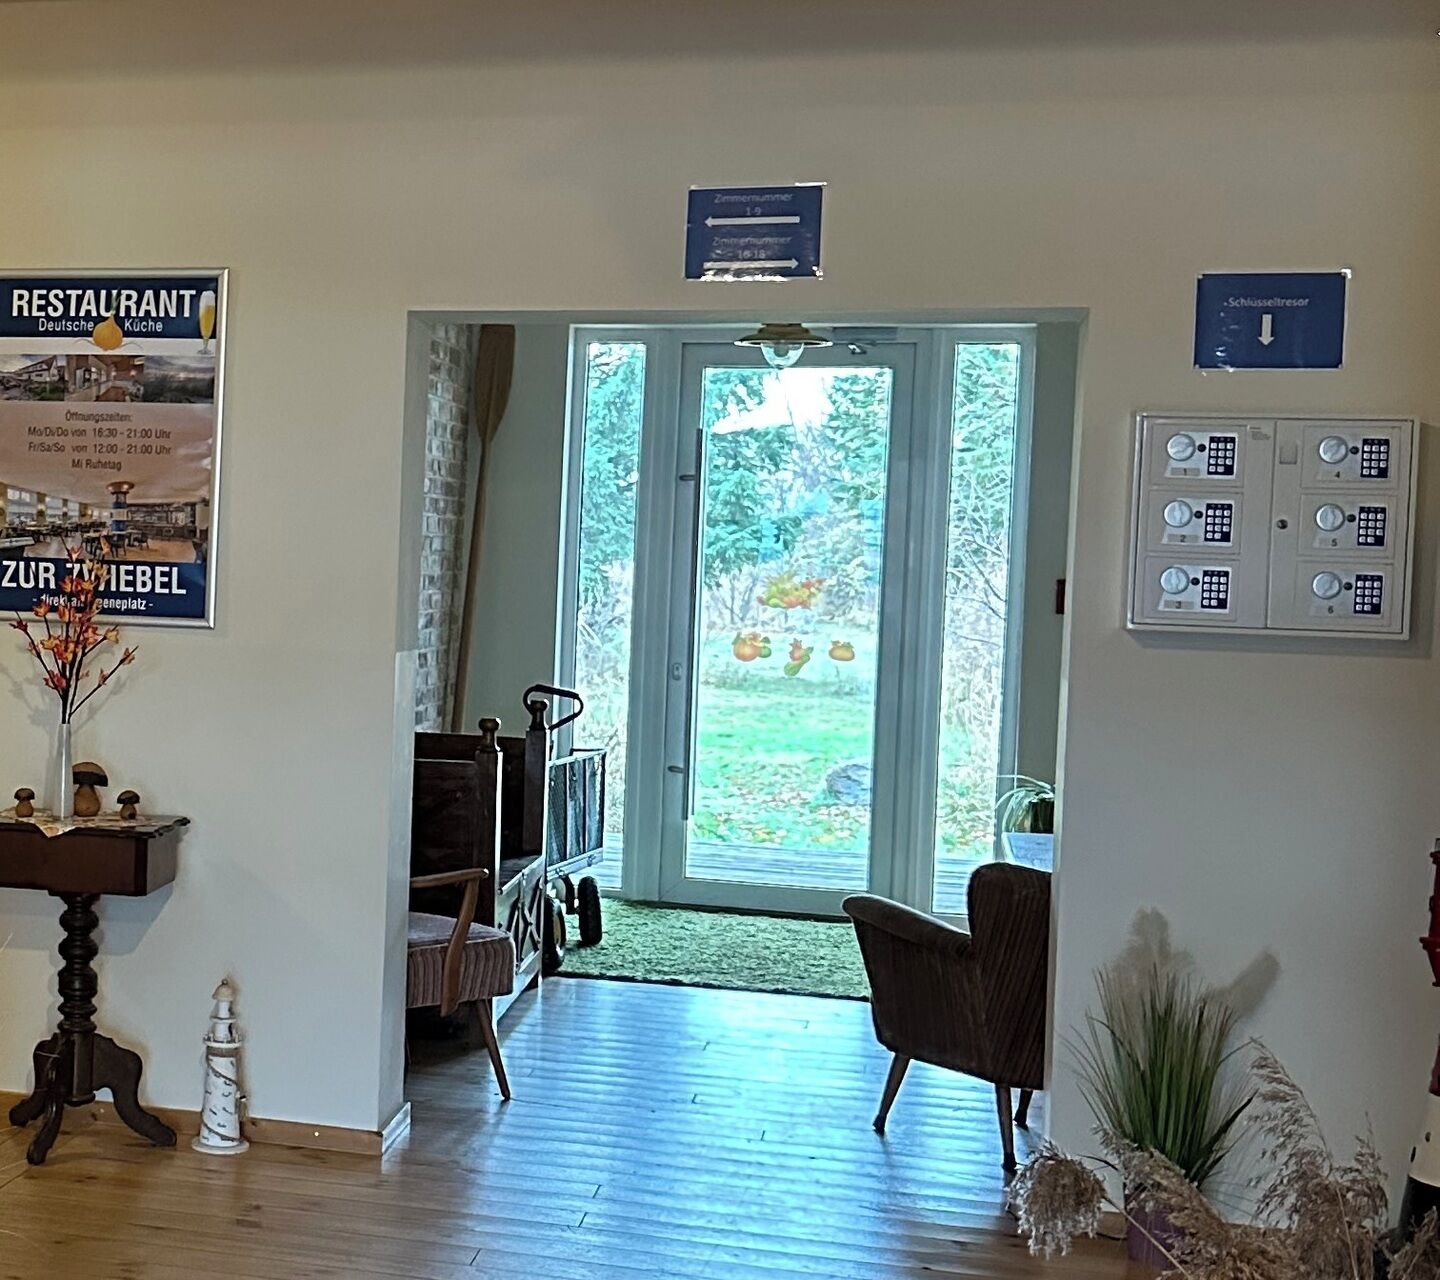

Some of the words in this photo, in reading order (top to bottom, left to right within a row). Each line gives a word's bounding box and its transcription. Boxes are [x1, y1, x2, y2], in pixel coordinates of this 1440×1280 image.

[714, 193, 793, 203] Zimmernummer
[12, 289, 196, 317] RESTAURANT
[1228, 297, 1309, 307] Schlüsseltresor
[38, 318, 94, 332] Deutsche
[124, 318, 162, 332] Küche
[70, 429, 87, 438] von
[127, 428, 152, 439] 21:00
[155, 429, 171, 439] Uhr
[72, 445, 87, 453] von
[93, 443, 118, 454] 12:00
[127, 444, 152, 455] 21:00
[155, 444, 171, 455] Uhr
[85, 459, 122, 471] Ruhetag
[1, 560, 56, 589] ZUR
[93, 596, 146, 611] eeneplatz
